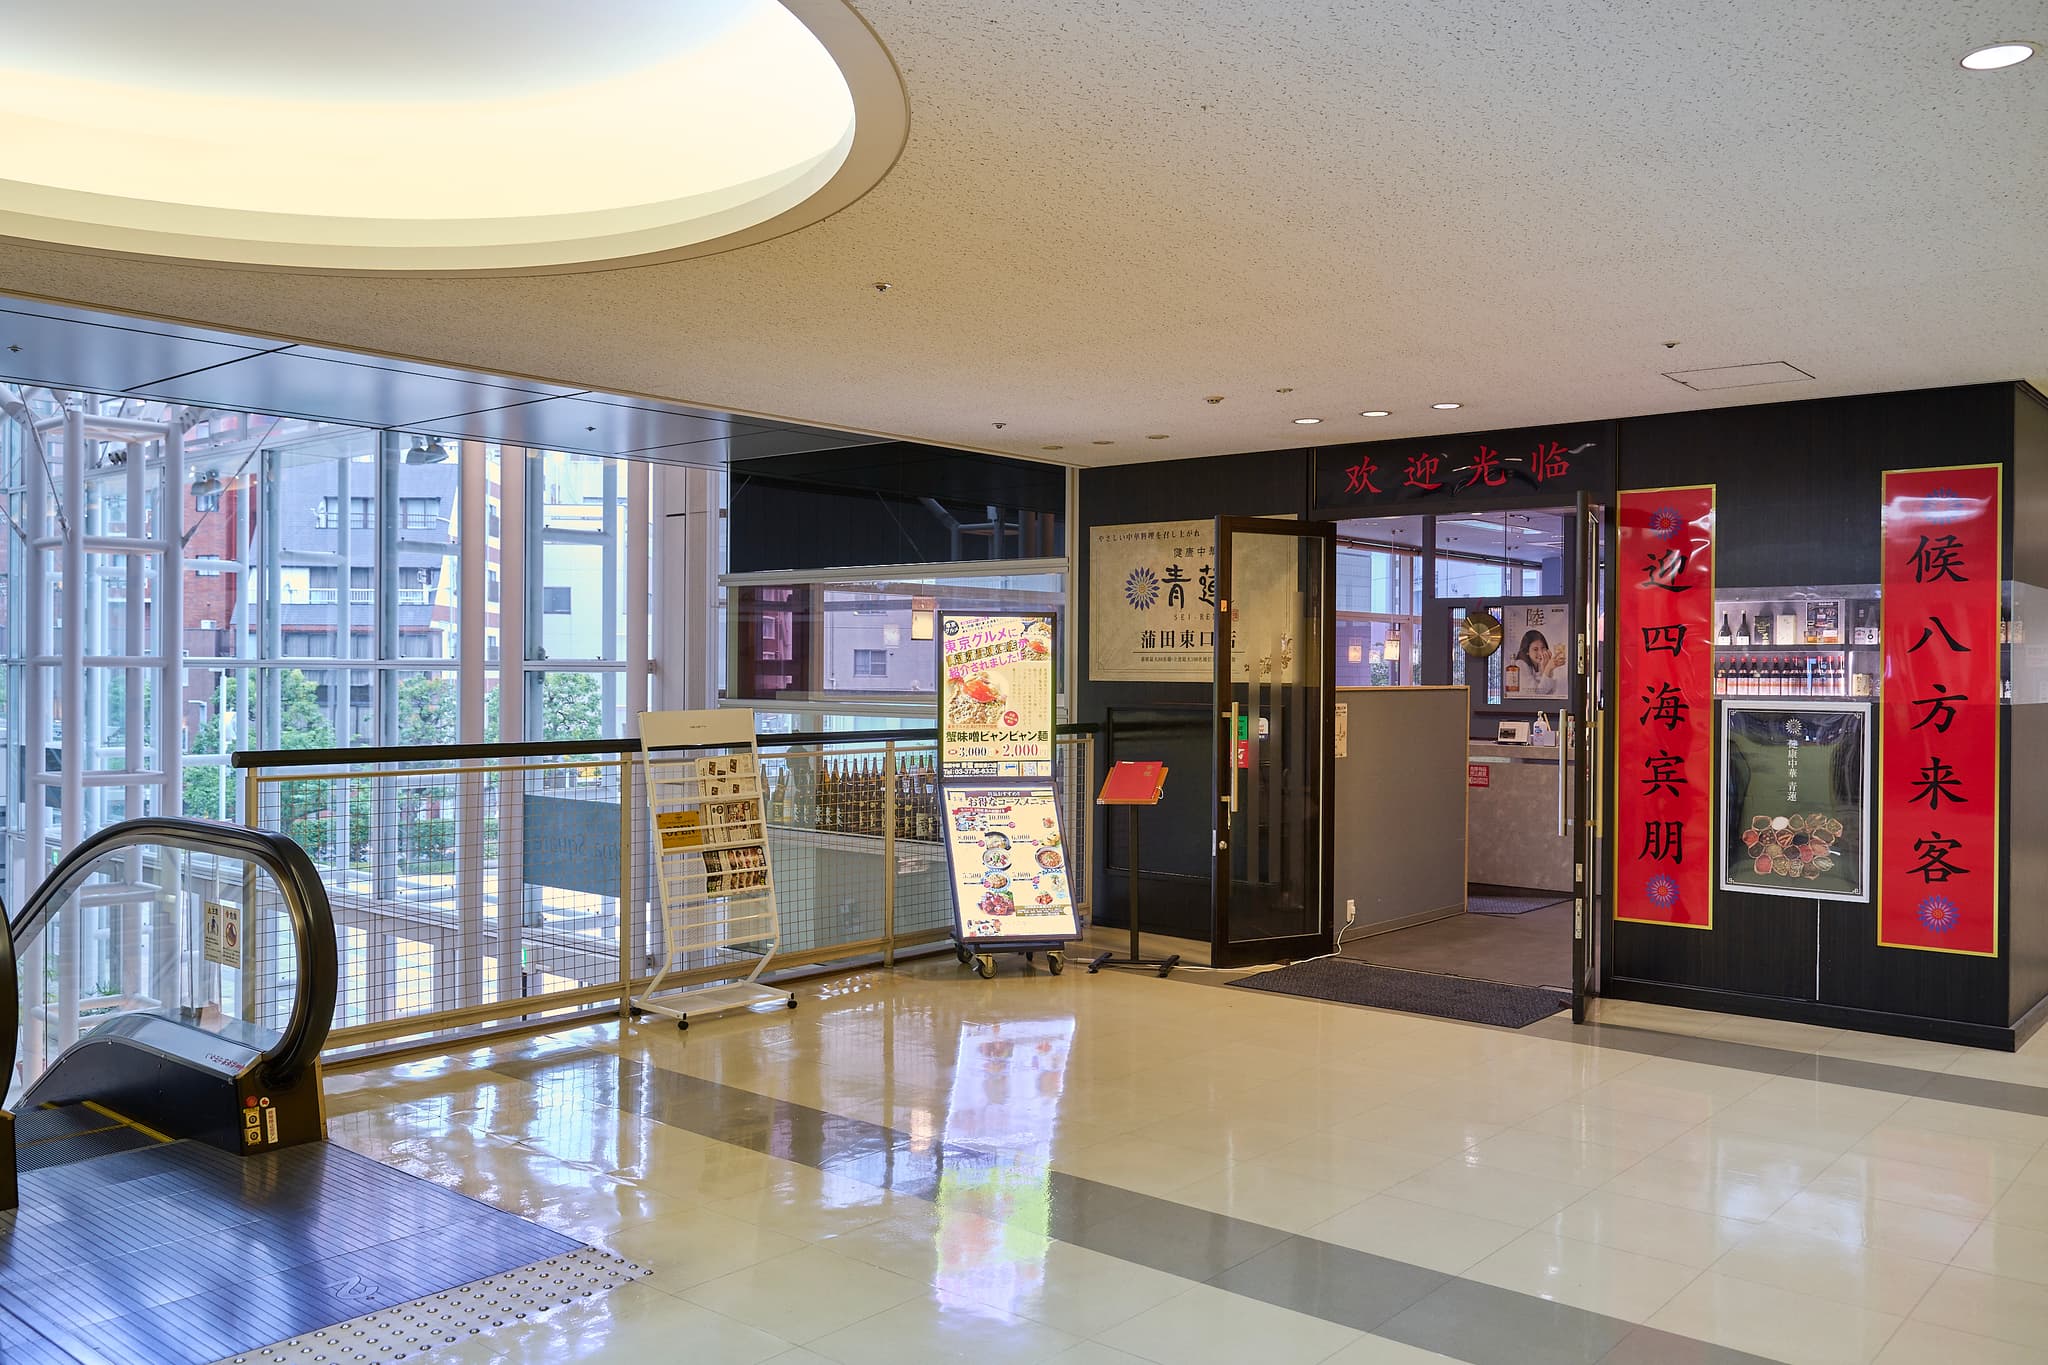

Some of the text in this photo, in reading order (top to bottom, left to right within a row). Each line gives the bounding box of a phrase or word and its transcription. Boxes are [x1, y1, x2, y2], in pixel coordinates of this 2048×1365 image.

[1344, 441, 1570, 494] 欢迎光临
[944, 627, 1018, 654] 東京グルメに
[1140, 629, 1237, 649] 蒲田東口
[1638, 550, 1693, 866] 迎四海宾朋
[1906, 533, 1971, 884] 候八方来客
